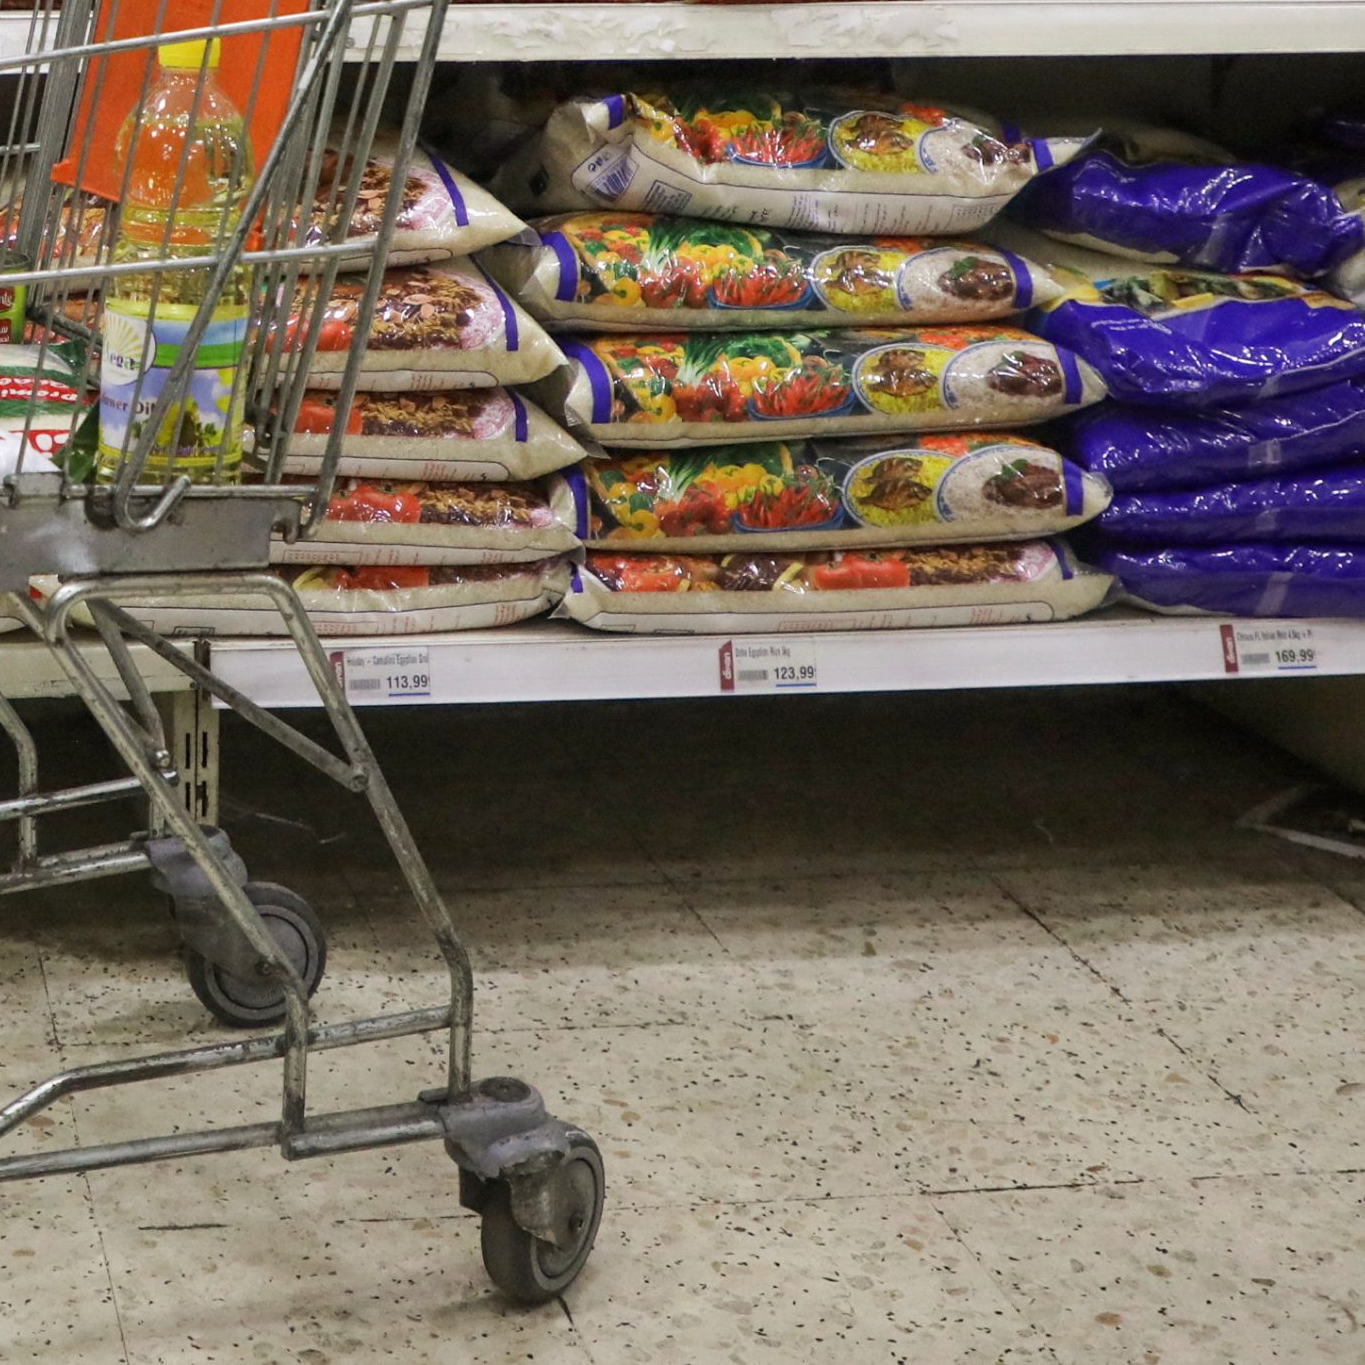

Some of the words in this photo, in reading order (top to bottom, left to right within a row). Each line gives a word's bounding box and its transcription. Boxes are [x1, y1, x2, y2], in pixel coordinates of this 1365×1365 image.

[1274, 648, 1316, 664] 169,99
[774, 665, 817, 681] 123,99
[386, 674, 430, 690] 113,99
